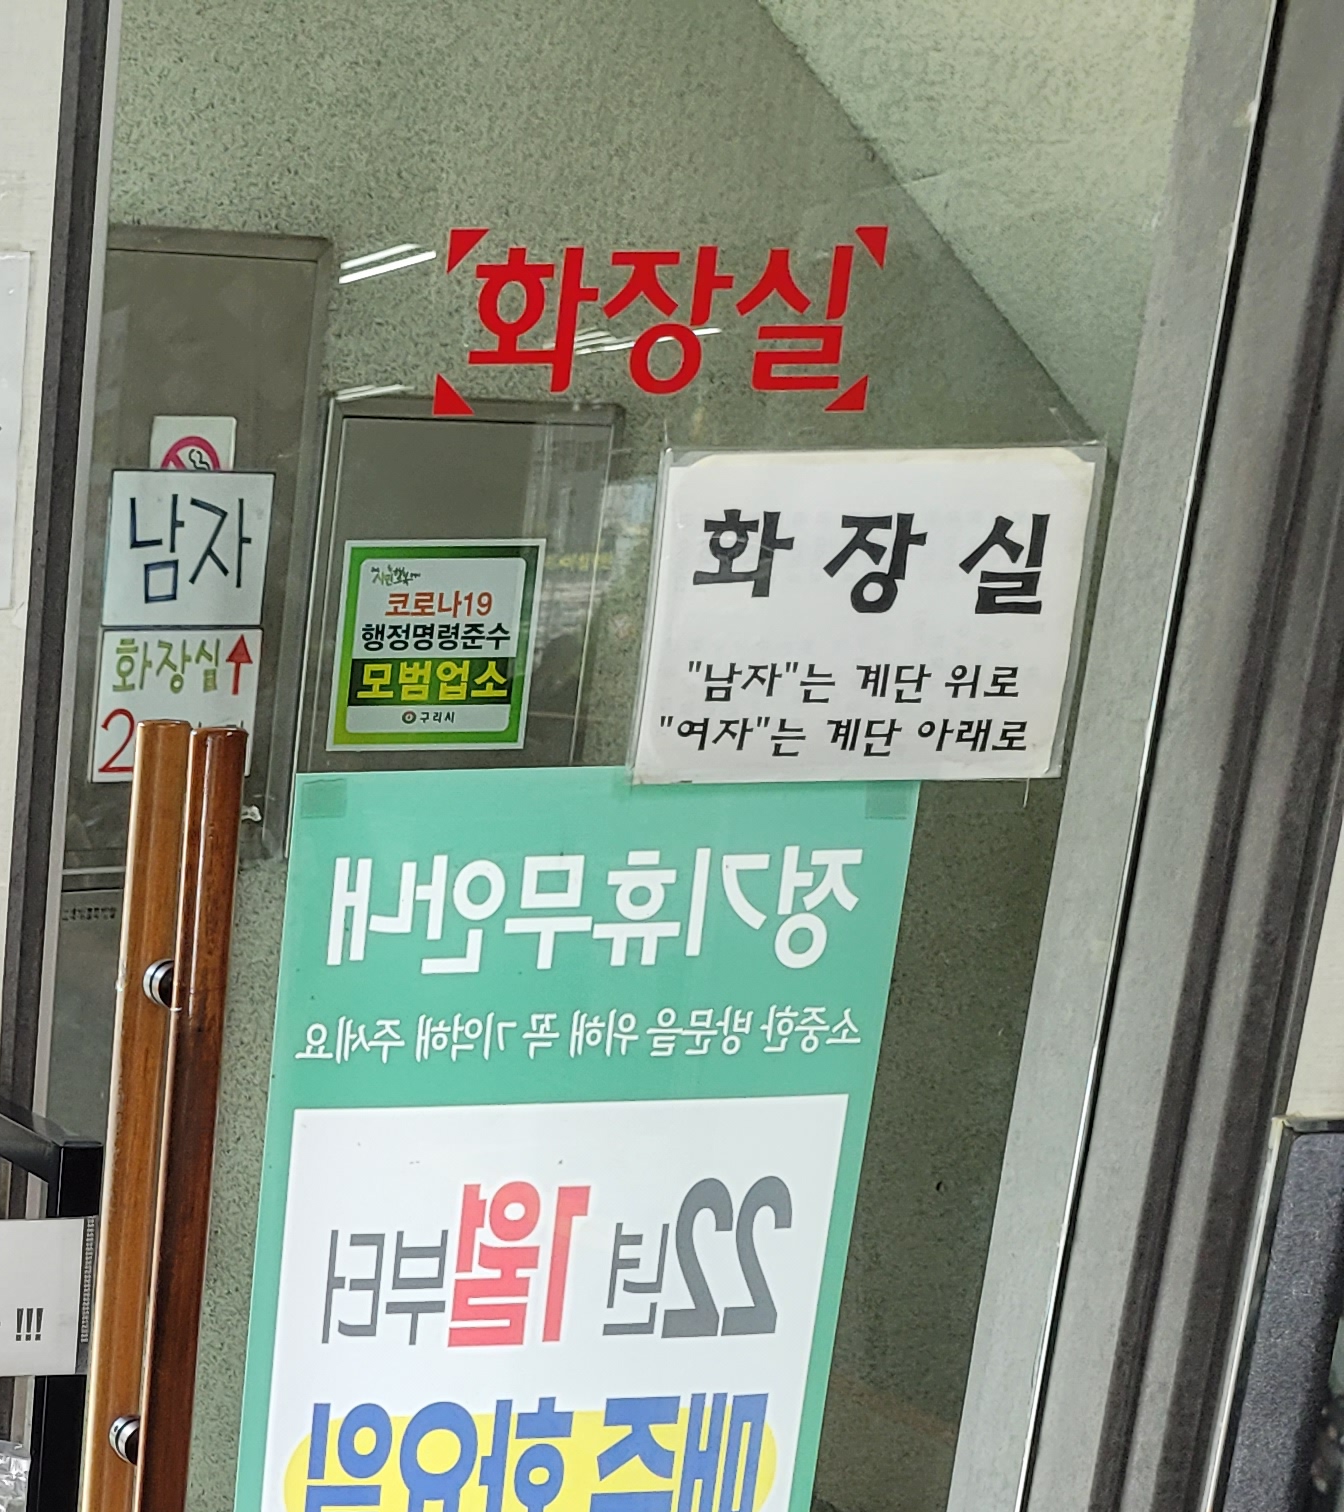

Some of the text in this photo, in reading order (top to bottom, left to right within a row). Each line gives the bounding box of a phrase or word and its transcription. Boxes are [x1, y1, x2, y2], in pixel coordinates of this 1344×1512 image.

[466, 245, 855, 394] 화장실
[128, 493, 252, 605] 남자
[385, 590, 493, 618] 코로나19
[361, 622, 511, 652] 행정명령준수
[112, 637, 221, 694] 화장실
[356, 660, 508, 701] 모범업소
[686, 660, 1020, 705] "남자"는 계단 위로
[419, 710, 456, 724] 구리시
[659, 715, 1028, 757] "여자"는 계단 아래로
